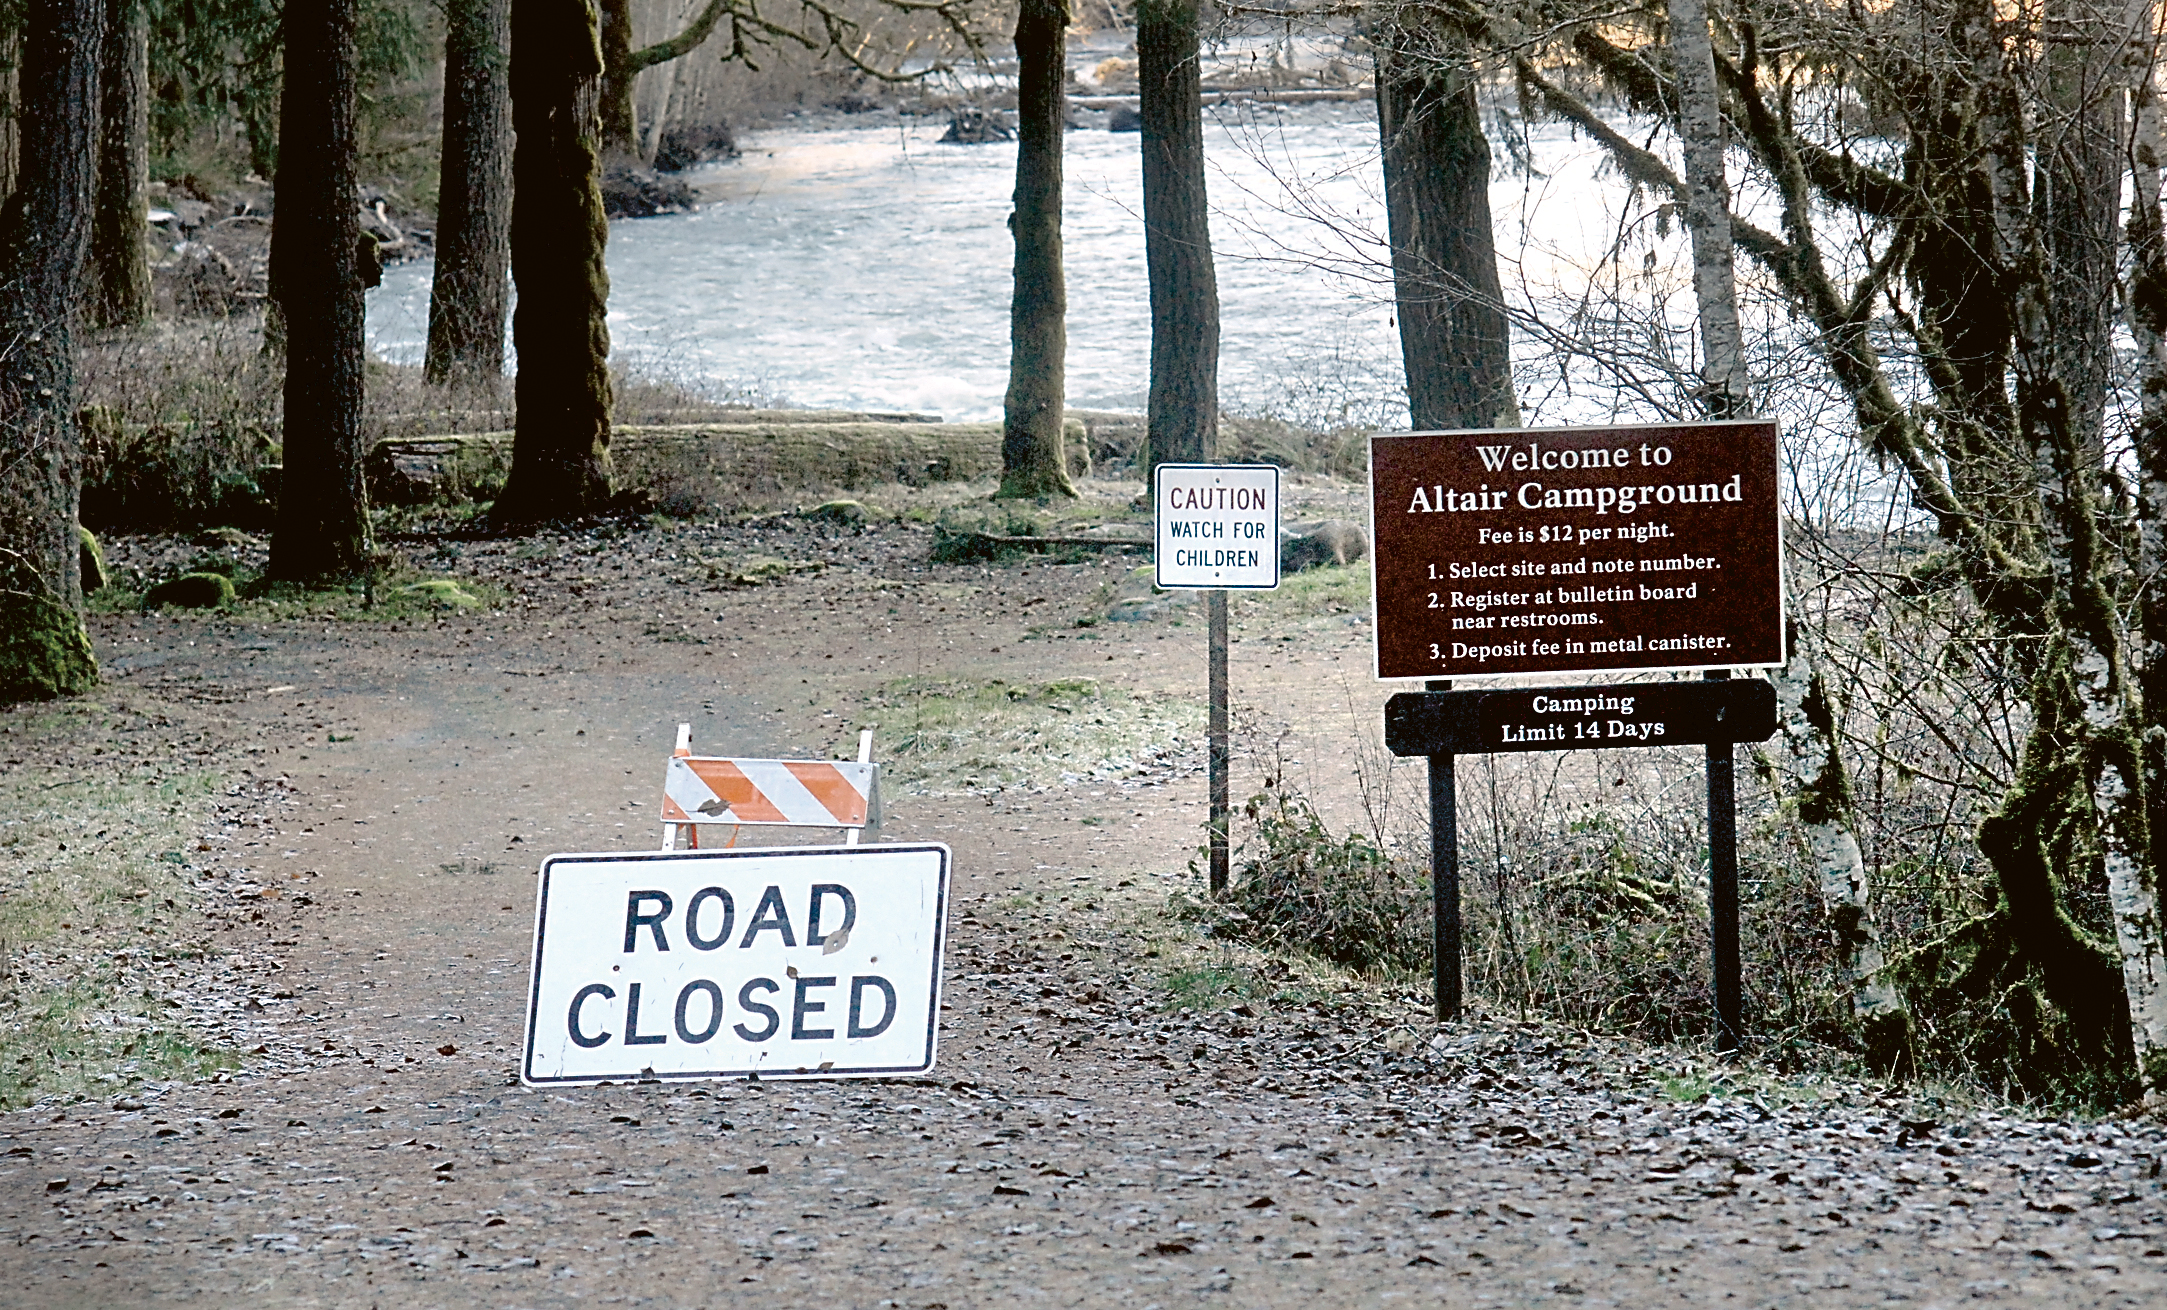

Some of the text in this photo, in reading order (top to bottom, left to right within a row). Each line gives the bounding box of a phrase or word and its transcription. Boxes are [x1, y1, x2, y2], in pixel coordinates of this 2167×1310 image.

[1476, 443, 1672, 472] Welcome to
[1171, 487, 1265, 510] CAUTION
[1407, 475, 1742, 514] Altair Campground
[1171, 521, 1265, 538] WATCH FOR
[1479, 523, 1674, 545] Fee is $12 per night.
[1177, 550, 1258, 566] CHILDREN
[1428, 554, 1720, 580] 1. Select site and note number.
[1428, 583, 1697, 611] 2. Register at bulletin board
[1452, 611, 1604, 630] near restrooms.
[1429, 634, 1731, 662] 3. Deposit fee in metal canister.
[1533, 695, 1634, 715] Camping
[1502, 720, 1665, 742] Limit 14 Days
[623, 884, 856, 953] ROAD
[567, 976, 897, 1048] CLOSED
